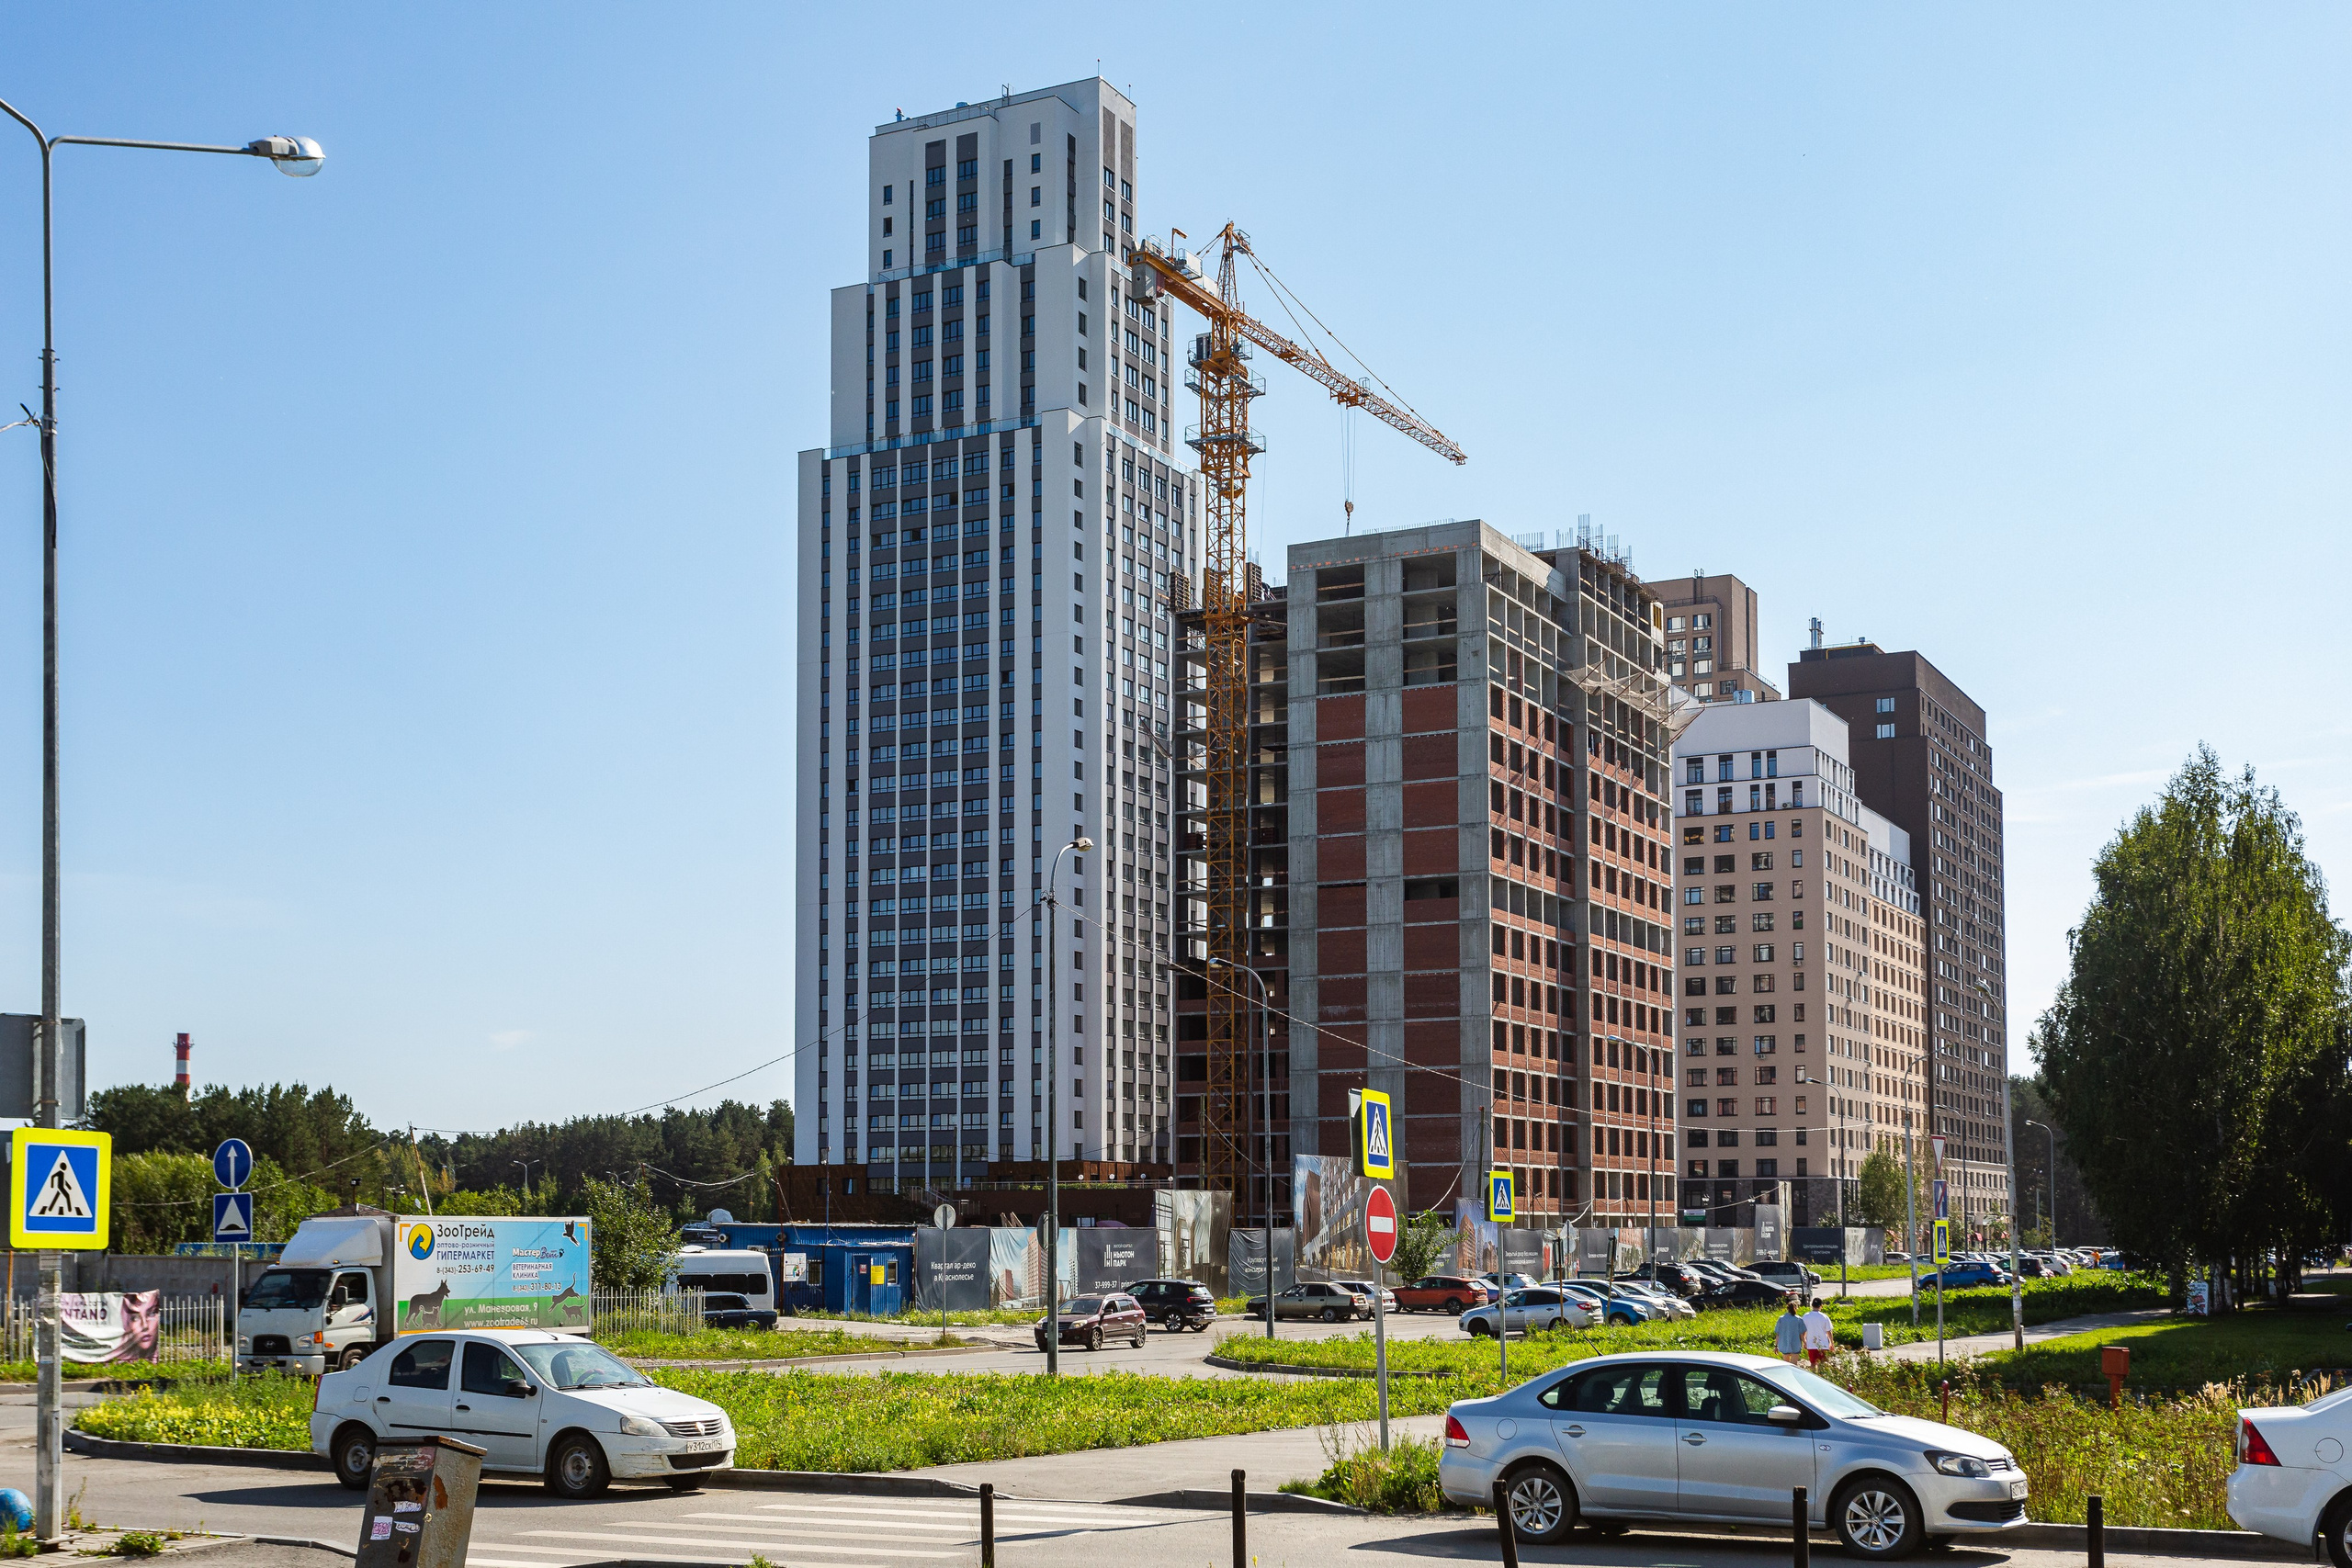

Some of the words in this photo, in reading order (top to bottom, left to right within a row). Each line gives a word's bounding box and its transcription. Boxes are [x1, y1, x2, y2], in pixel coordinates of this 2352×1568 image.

[436, 1224, 495, 1241] ЗооТрейд
[435, 1241, 495, 1250] оптово-розничный
[436, 1250, 495, 1260] ГИПЕРМАРКЕТ
[1113, 1250, 1135, 1258] НЬЮТОН
[954, 1262, 977, 1271] ар-деко
[1113, 1258, 1127, 1267] ПАРК
[435, 1264, 495, 1275] 8-(343)-253-69-49
[1094, 1280, 1118, 1289] 37-999-37
[464, 1306, 476, 1315] ул.
[533, 1302, 538, 1312] 9
[464, 1316, 538, 1327] www.zootrade66ru
